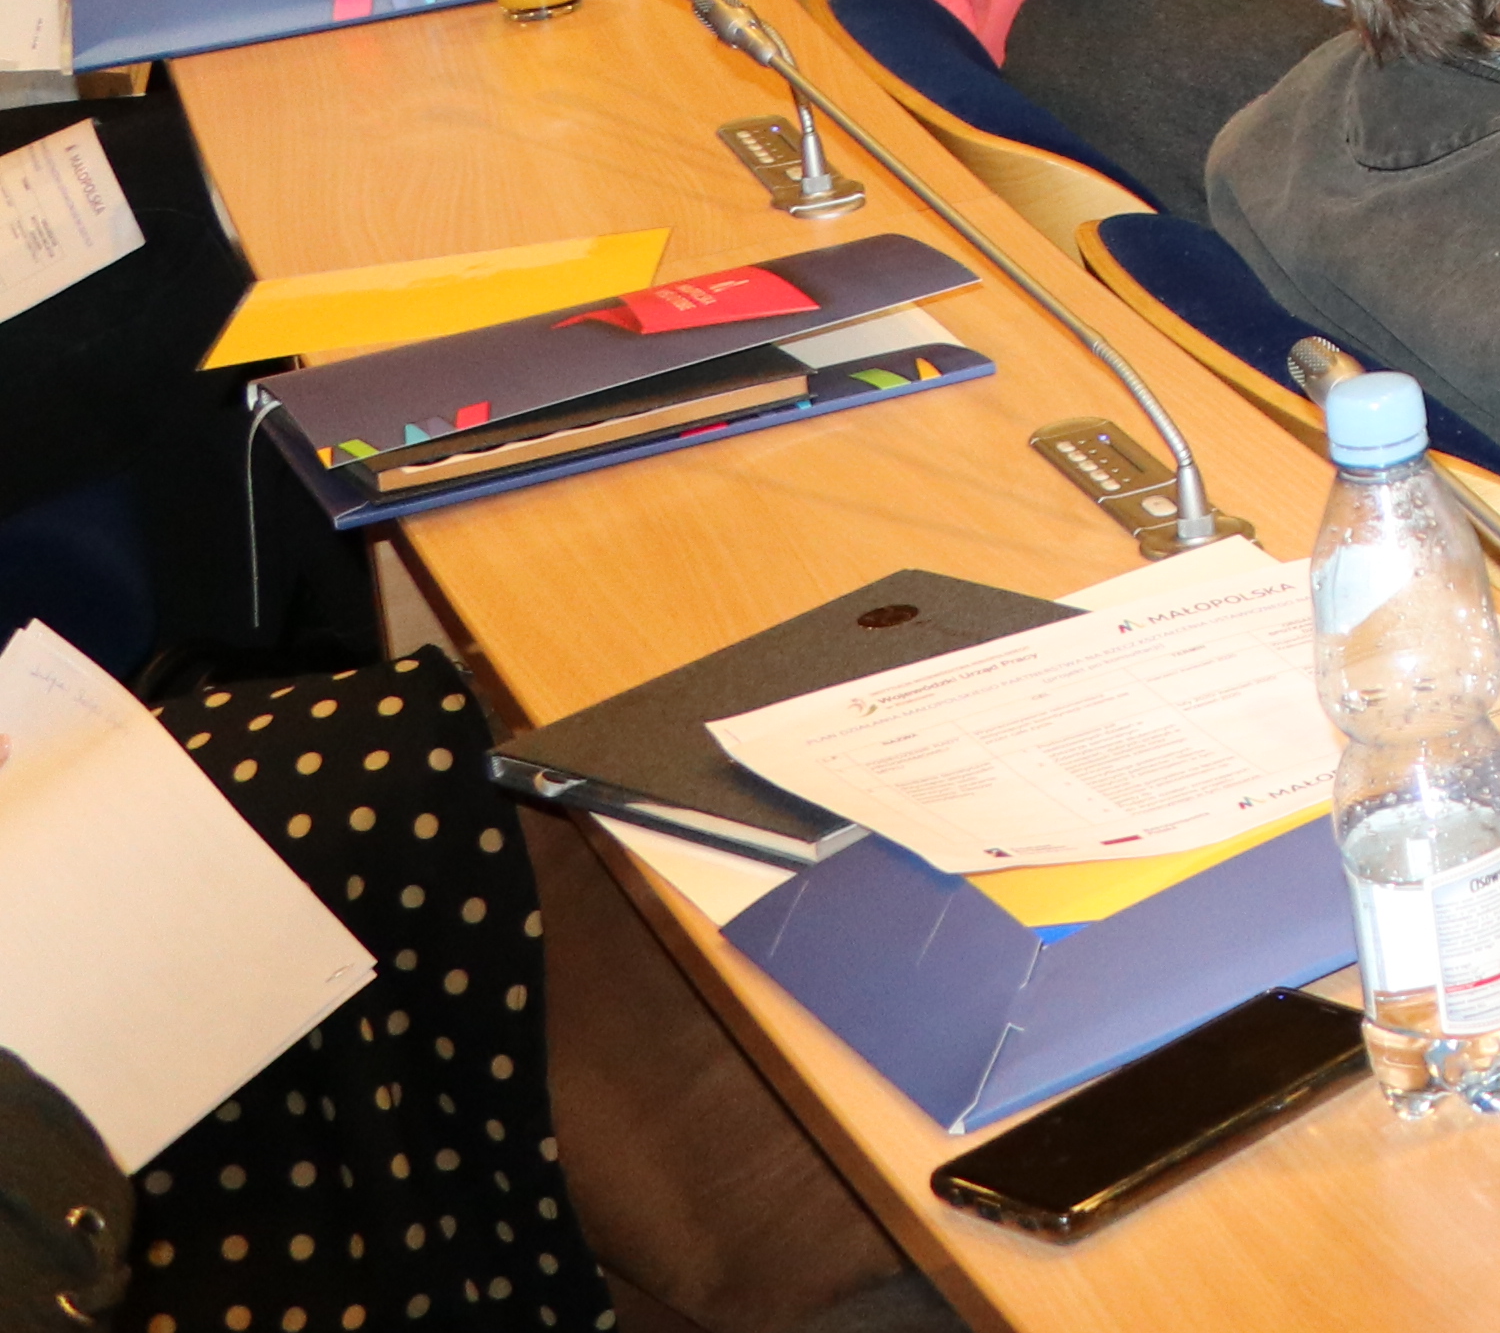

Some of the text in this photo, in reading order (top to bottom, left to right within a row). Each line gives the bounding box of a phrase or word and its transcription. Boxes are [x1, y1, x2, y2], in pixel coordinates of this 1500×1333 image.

[1147, 580, 1295, 626] MAŁOPOLSKA
[877, 675, 957, 707] Wojewódzki
[999, 651, 1039, 668] Pracy
